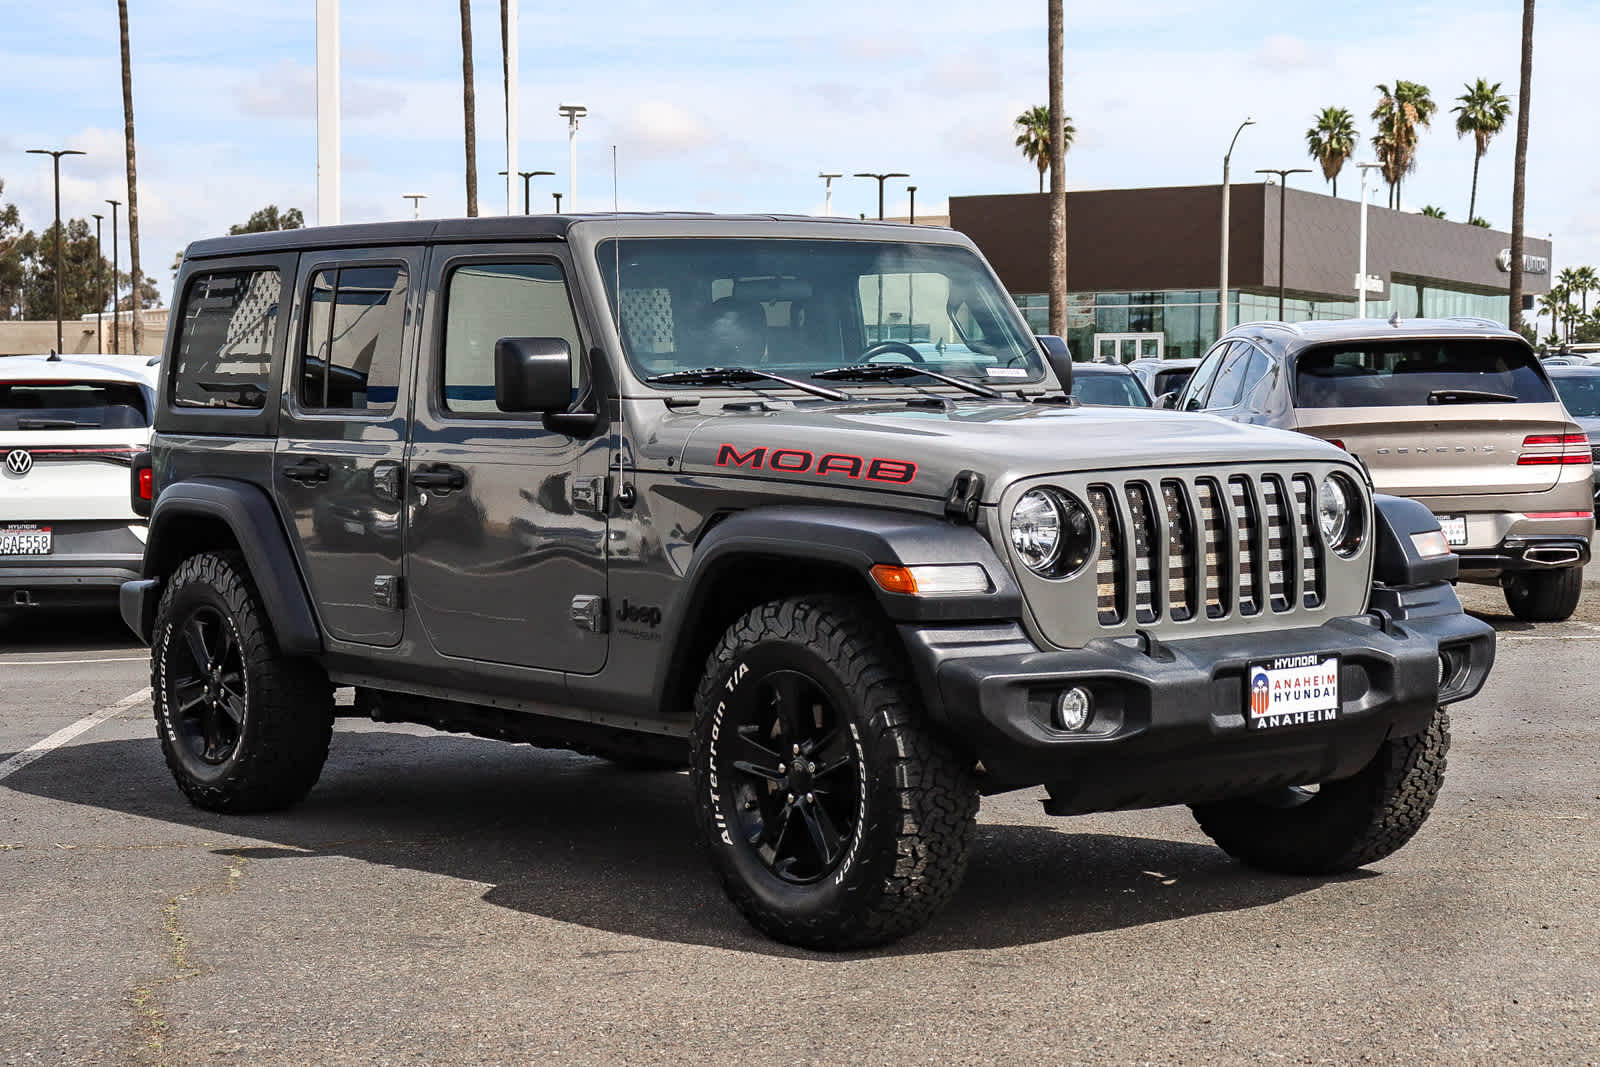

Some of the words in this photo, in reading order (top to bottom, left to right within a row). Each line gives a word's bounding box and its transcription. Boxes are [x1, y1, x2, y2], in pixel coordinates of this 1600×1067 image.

[716, 443, 918, 485] MOAB
[616, 599, 662, 629] Jeep
[1274, 655, 1318, 669] HYUNDAI
[1274, 674, 1336, 690] ANAHEIM
[1274, 686, 1336, 703] HYUNDAI
[1257, 708, 1337, 729] ANAHEIM
[710, 701, 735, 846] All-Terrain
[725, 662, 750, 693] T/A
